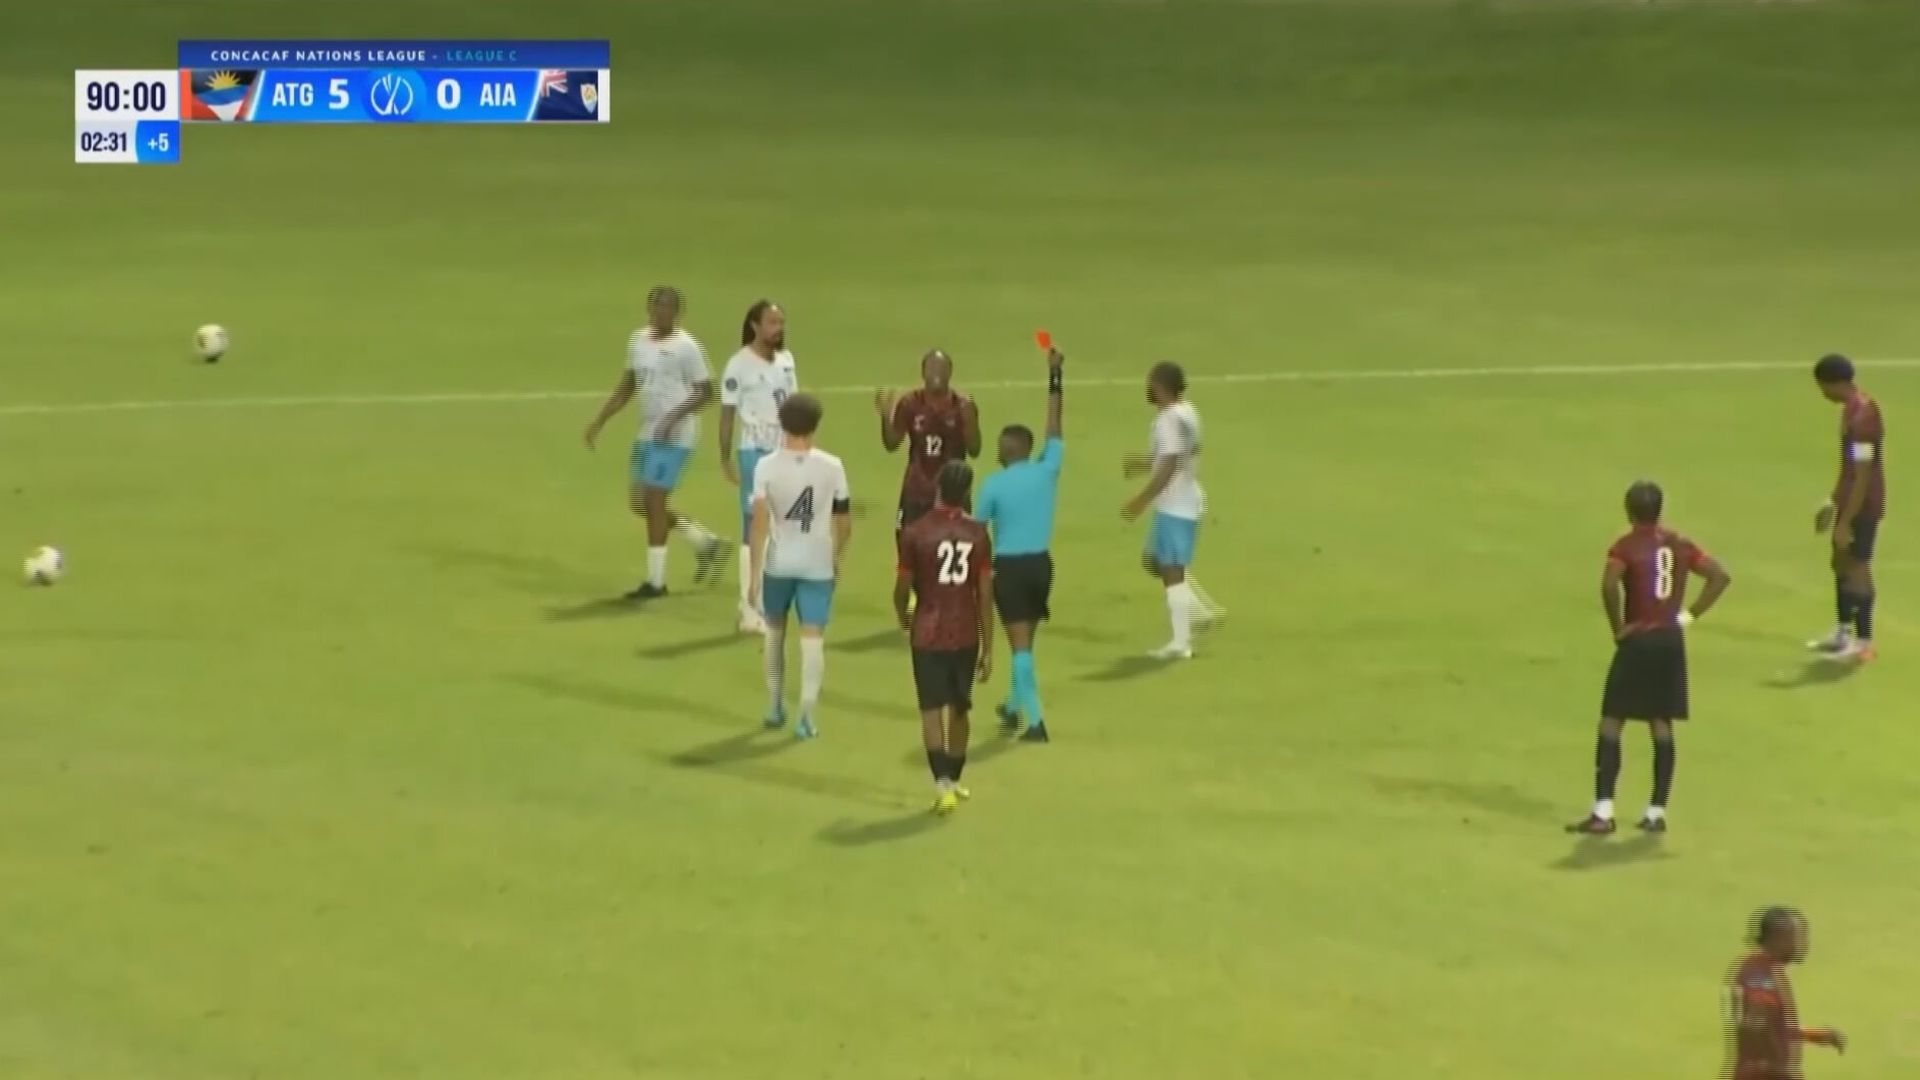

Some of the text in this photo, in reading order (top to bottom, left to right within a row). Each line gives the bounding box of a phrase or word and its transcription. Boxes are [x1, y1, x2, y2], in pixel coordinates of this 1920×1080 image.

[926, 434, 942, 456] 12
[784, 485, 814, 533] 4
[937, 541, 973, 585] 23
[1656, 547, 1674, 600] 8
